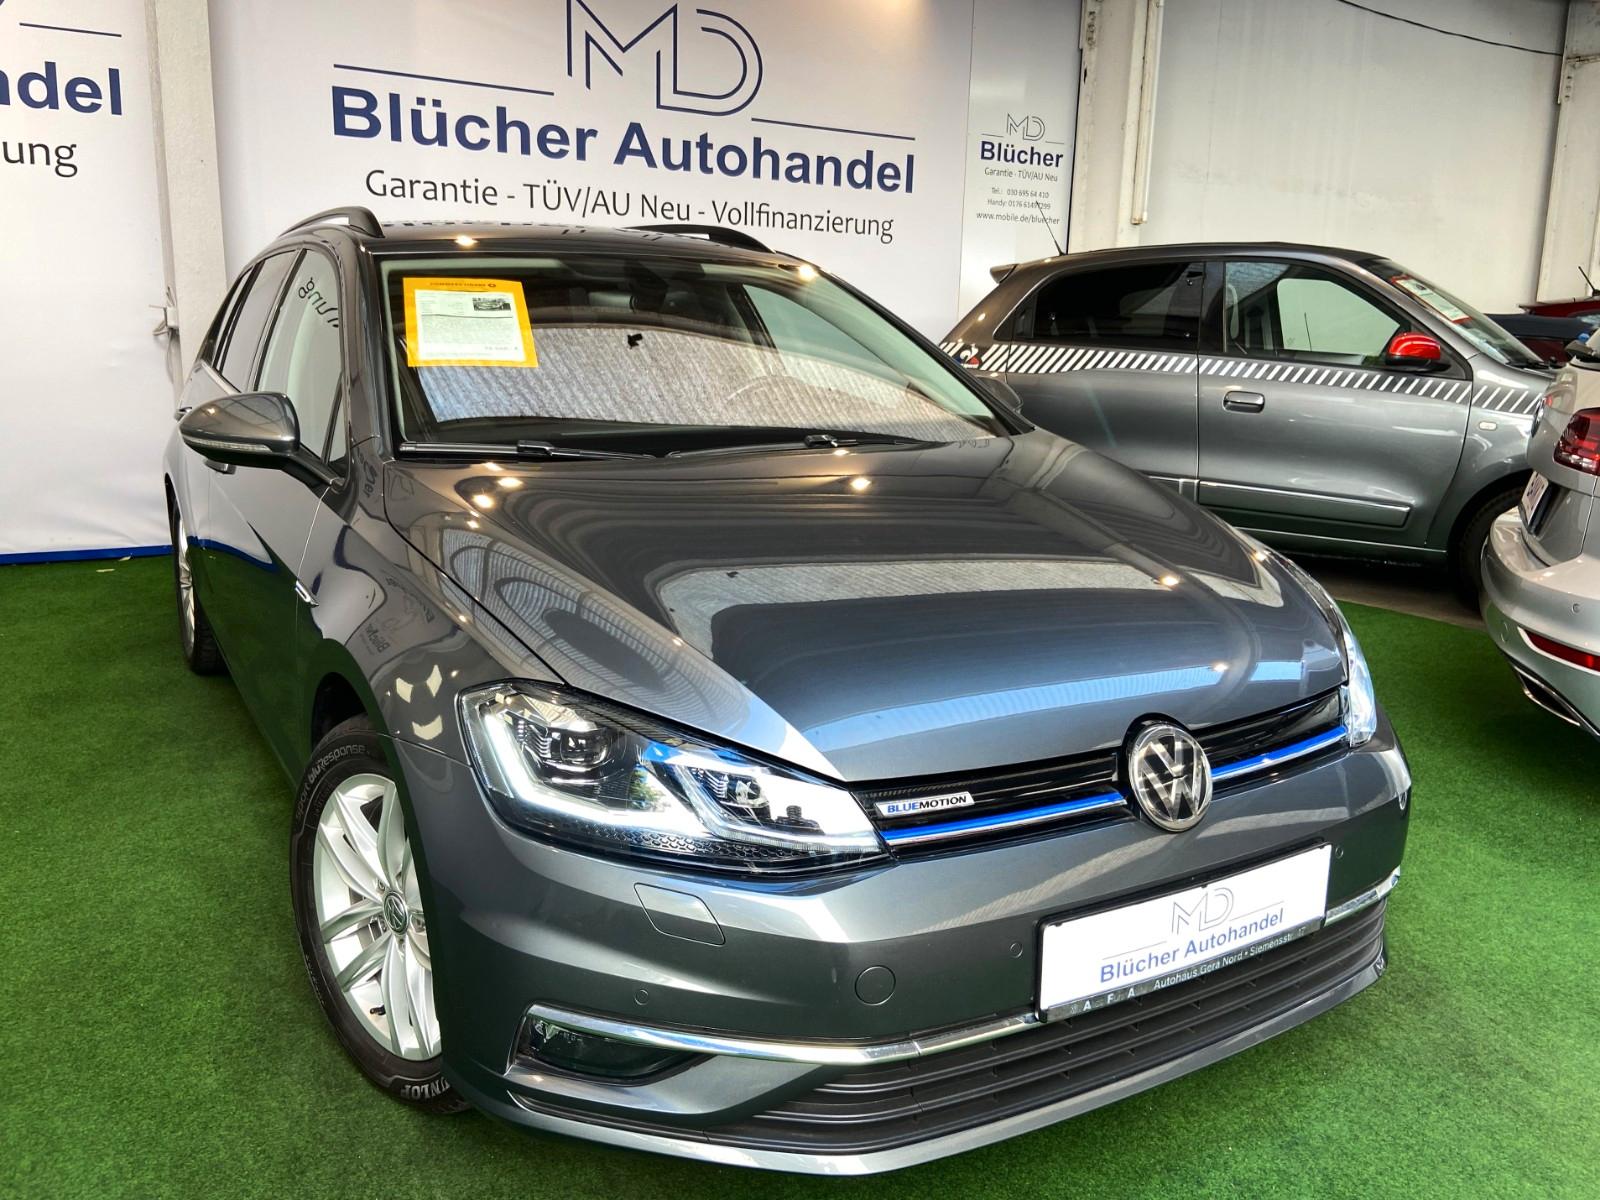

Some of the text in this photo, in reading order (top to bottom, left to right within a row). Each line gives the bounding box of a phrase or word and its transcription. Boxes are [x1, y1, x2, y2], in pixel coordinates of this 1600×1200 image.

[0, 61, 122, 116] del
[332, 86, 915, 193] Blücher Autohandel
[980, 140, 1064, 168] Blücher
[2, 141, 78, 178] ung
[984, 167, 1014, 178] Garantie
[1045, 172, 1058, 182] Neu
[366, 169, 498, 206] Garantie
[523, 180, 630, 218] TÜV/AU
[641, 194, 690, 222] Neu
[712, 200, 894, 244] Vollfinanzierung
[887, 795, 967, 814] BLUEMOTION
[1100, 907, 1284, 983] Blücher Autohandel
[1153, 968, 1198, 990] Autohaus
[1222, 951, 1243, 966] Nord
